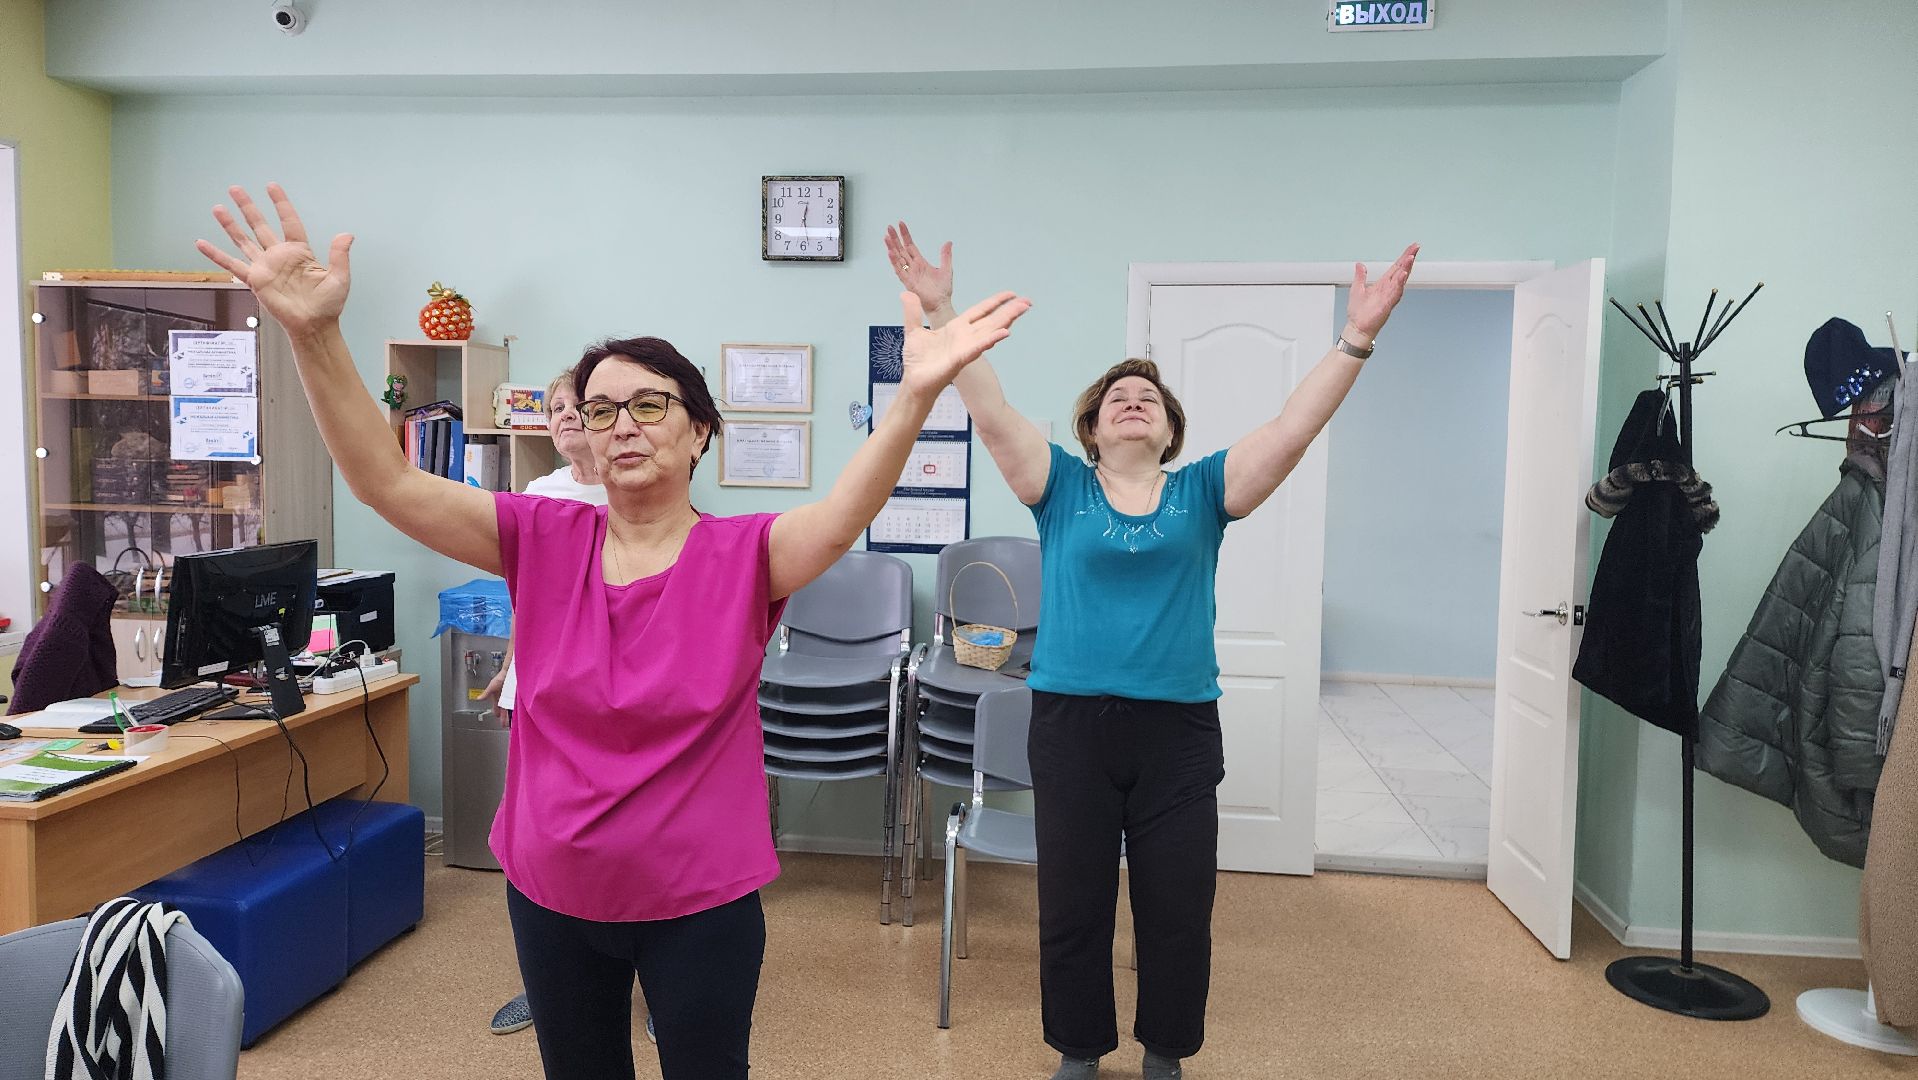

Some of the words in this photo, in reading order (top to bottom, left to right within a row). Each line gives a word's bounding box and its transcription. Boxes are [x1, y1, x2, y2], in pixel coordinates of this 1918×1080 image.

[1339, 2, 1423, 24] ВЫХОД
[780, 186, 793, 198] 11
[797, 186, 811, 198] 12
[817, 186, 824, 198] 1
[772, 197, 785, 208] 10
[826, 197, 834, 209] 2
[774, 213, 782, 224] 9
[826, 213, 834, 224] 3
[774, 229, 782, 241] 8
[784, 240, 792, 251] 7
[800, 240, 807, 251] 6
[816, 240, 823, 251] 5
